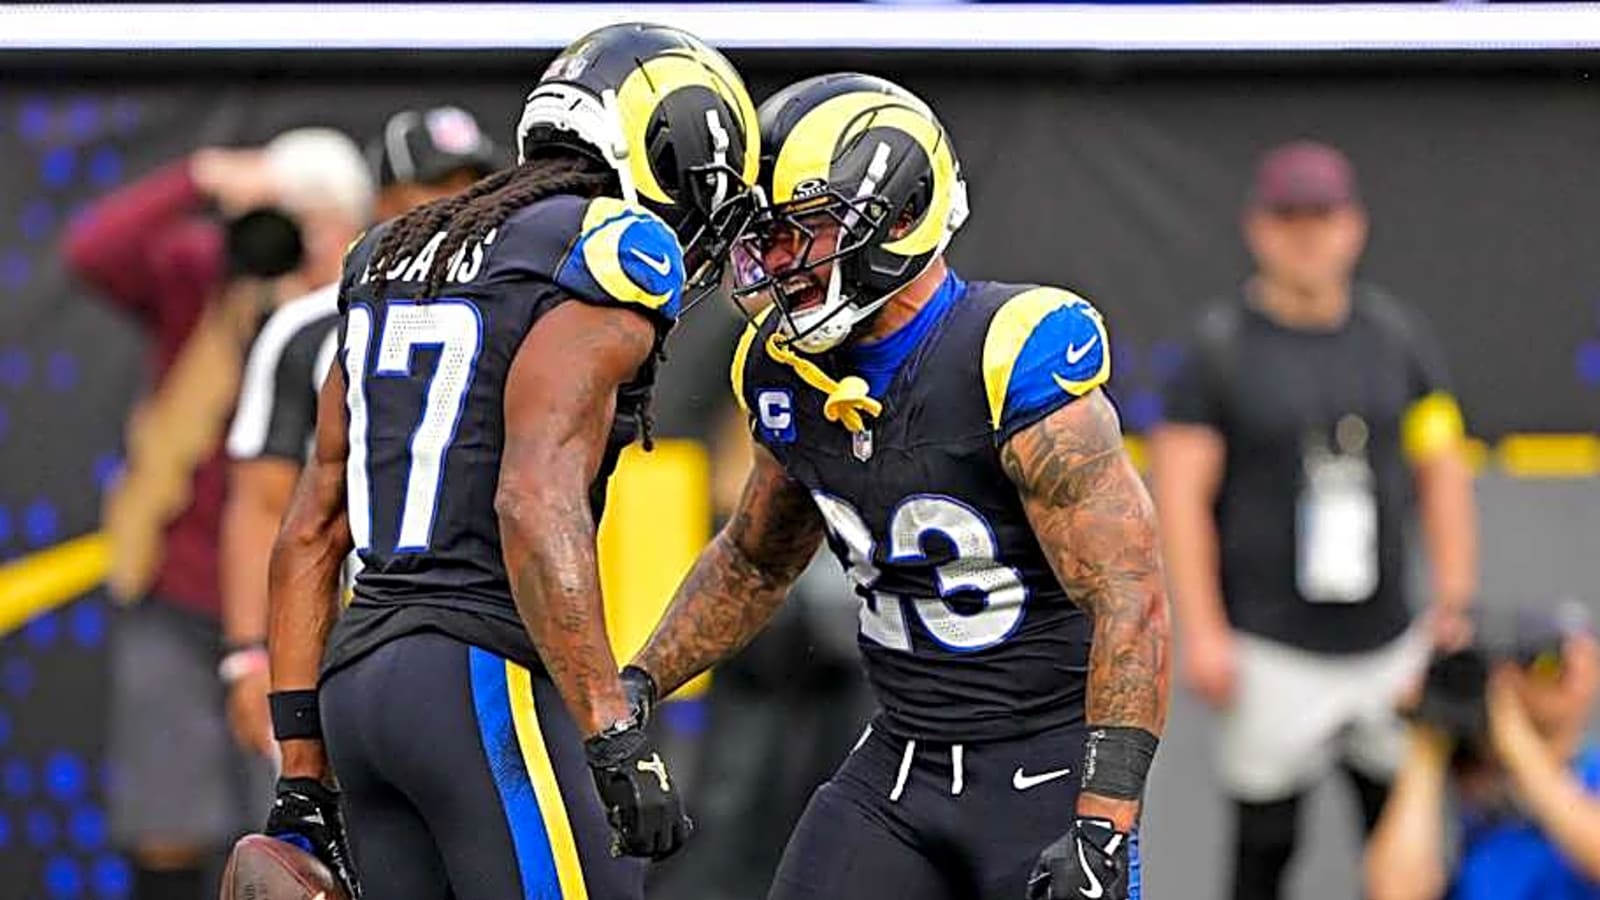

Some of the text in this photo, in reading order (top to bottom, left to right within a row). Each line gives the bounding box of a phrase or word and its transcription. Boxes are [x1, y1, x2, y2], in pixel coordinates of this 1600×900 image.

[345, 299, 483, 552] 17
[758, 391, 791, 429] C
[810, 491, 1028, 652] 23
